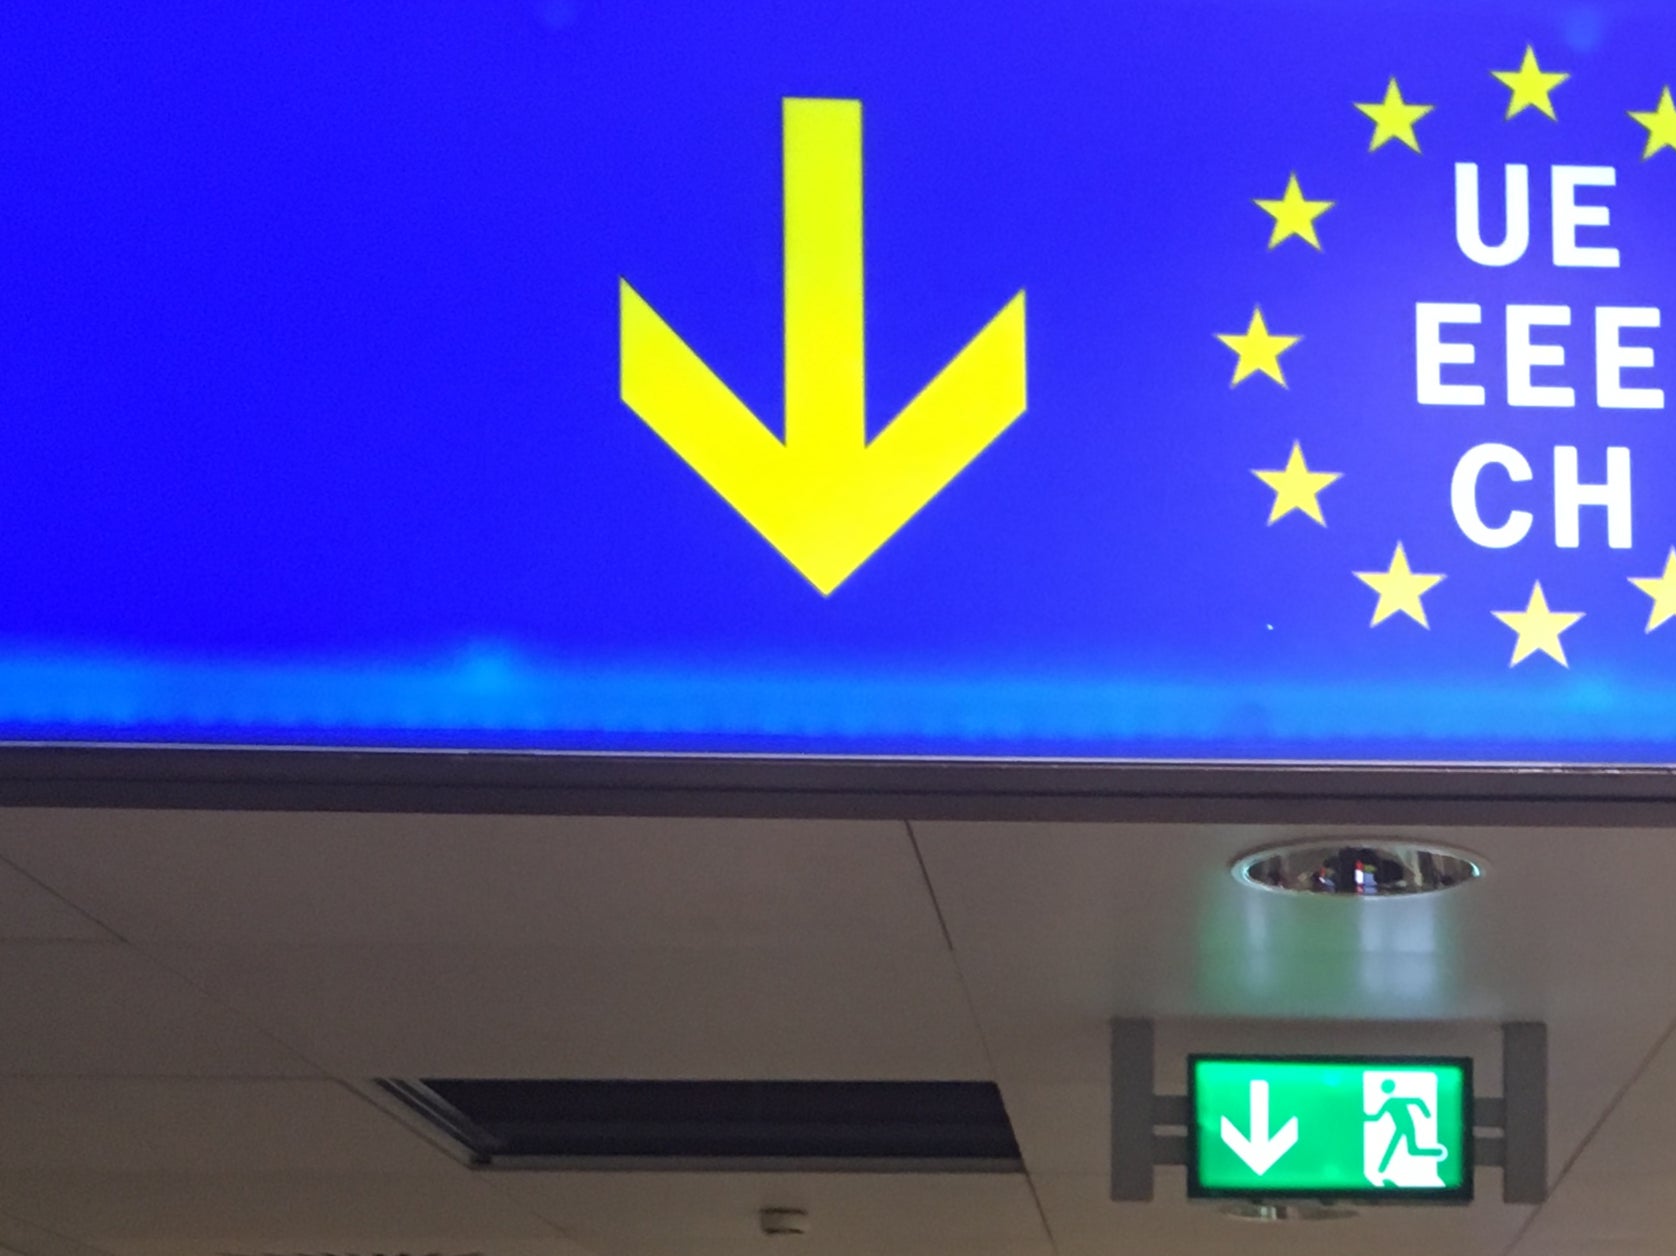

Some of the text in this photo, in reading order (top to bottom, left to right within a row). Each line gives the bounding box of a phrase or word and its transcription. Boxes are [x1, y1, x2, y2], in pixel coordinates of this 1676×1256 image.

[1454, 162, 1621, 268] UE
[1415, 301, 1666, 410] EEE
[1450, 442, 1633, 549] CH
